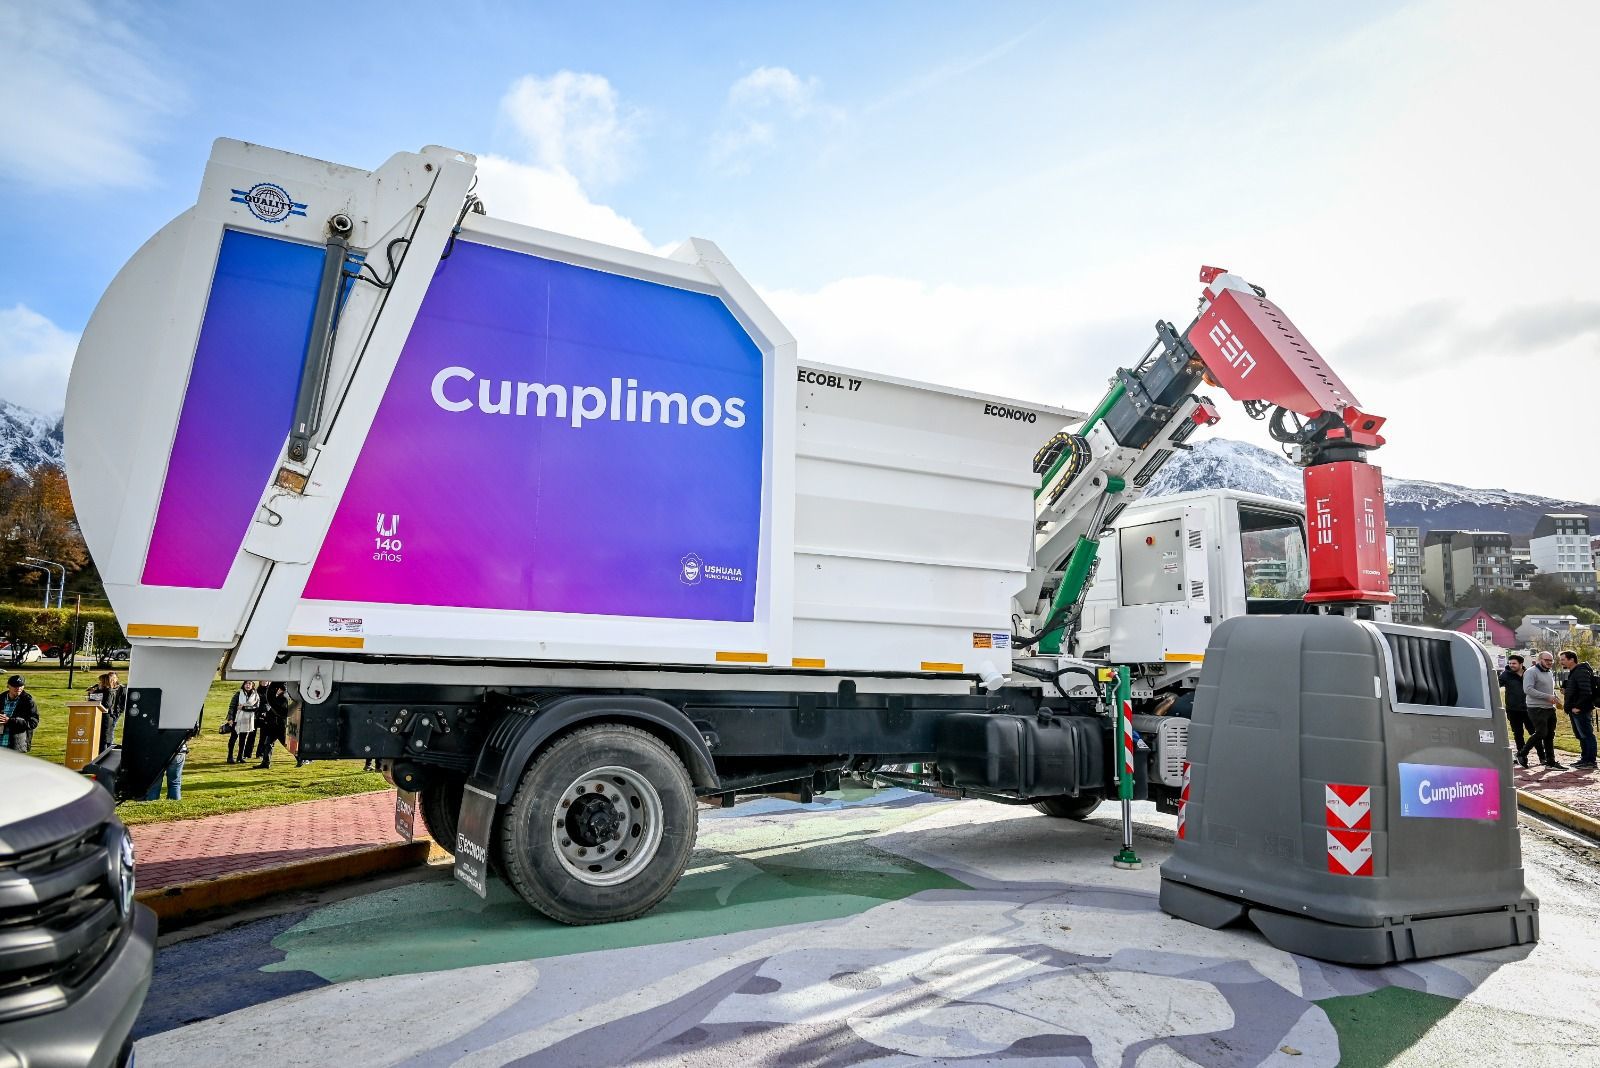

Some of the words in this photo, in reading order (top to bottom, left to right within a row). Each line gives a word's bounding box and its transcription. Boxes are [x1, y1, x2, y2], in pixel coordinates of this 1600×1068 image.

[244, 195, 294, 211] QUALITY
[797, 369, 845, 389] ECOBL
[848, 378, 862, 391] 17
[431, 366, 746, 429] Cumplimos
[984, 404, 1037, 424] ECONOVO
[375, 537, 402, 551] 140
[372, 551, 402, 563] años
[704, 565, 742, 576] USHUAIA
[704, 573, 743, 582] MUNICIPALIDAD
[1418, 779, 1484, 805] Cumplimos
